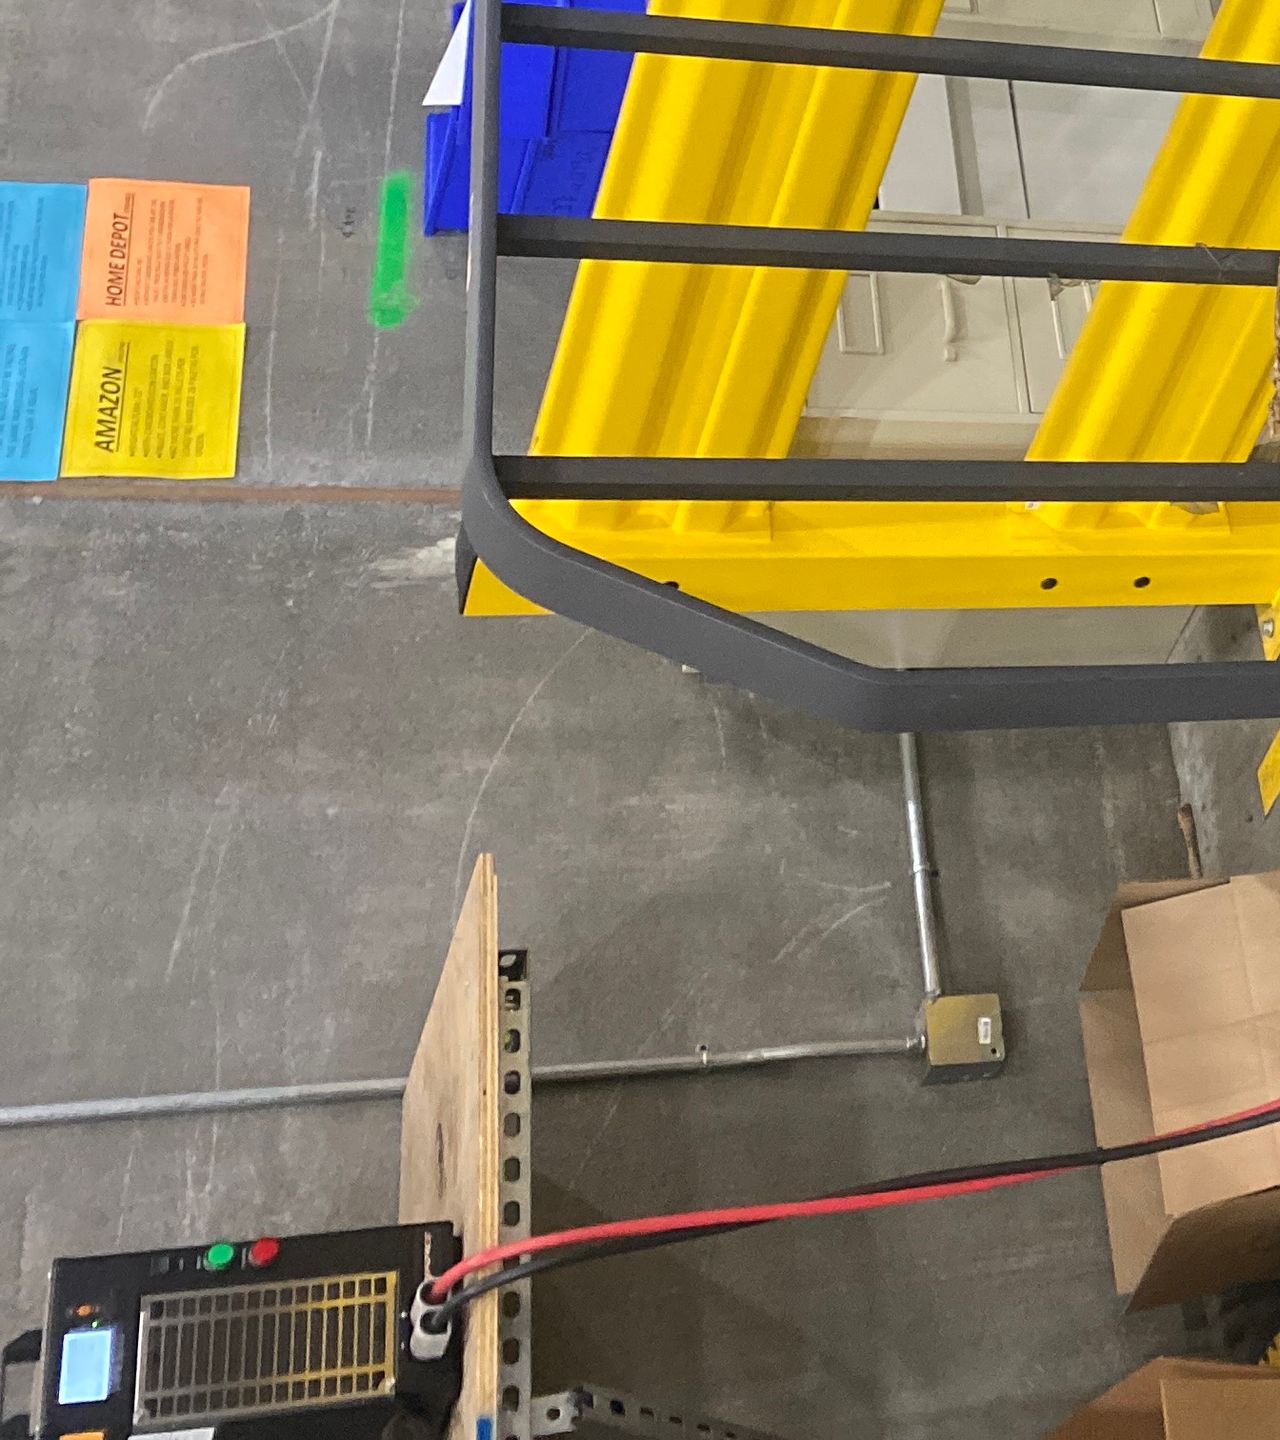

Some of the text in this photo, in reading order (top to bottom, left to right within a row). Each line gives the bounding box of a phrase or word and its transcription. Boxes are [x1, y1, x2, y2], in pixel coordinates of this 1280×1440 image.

[109, 212, 129, 260] DEPOT
[105, 263, 126, 307] HOME
[94, 366, 122, 453] AMAZON
